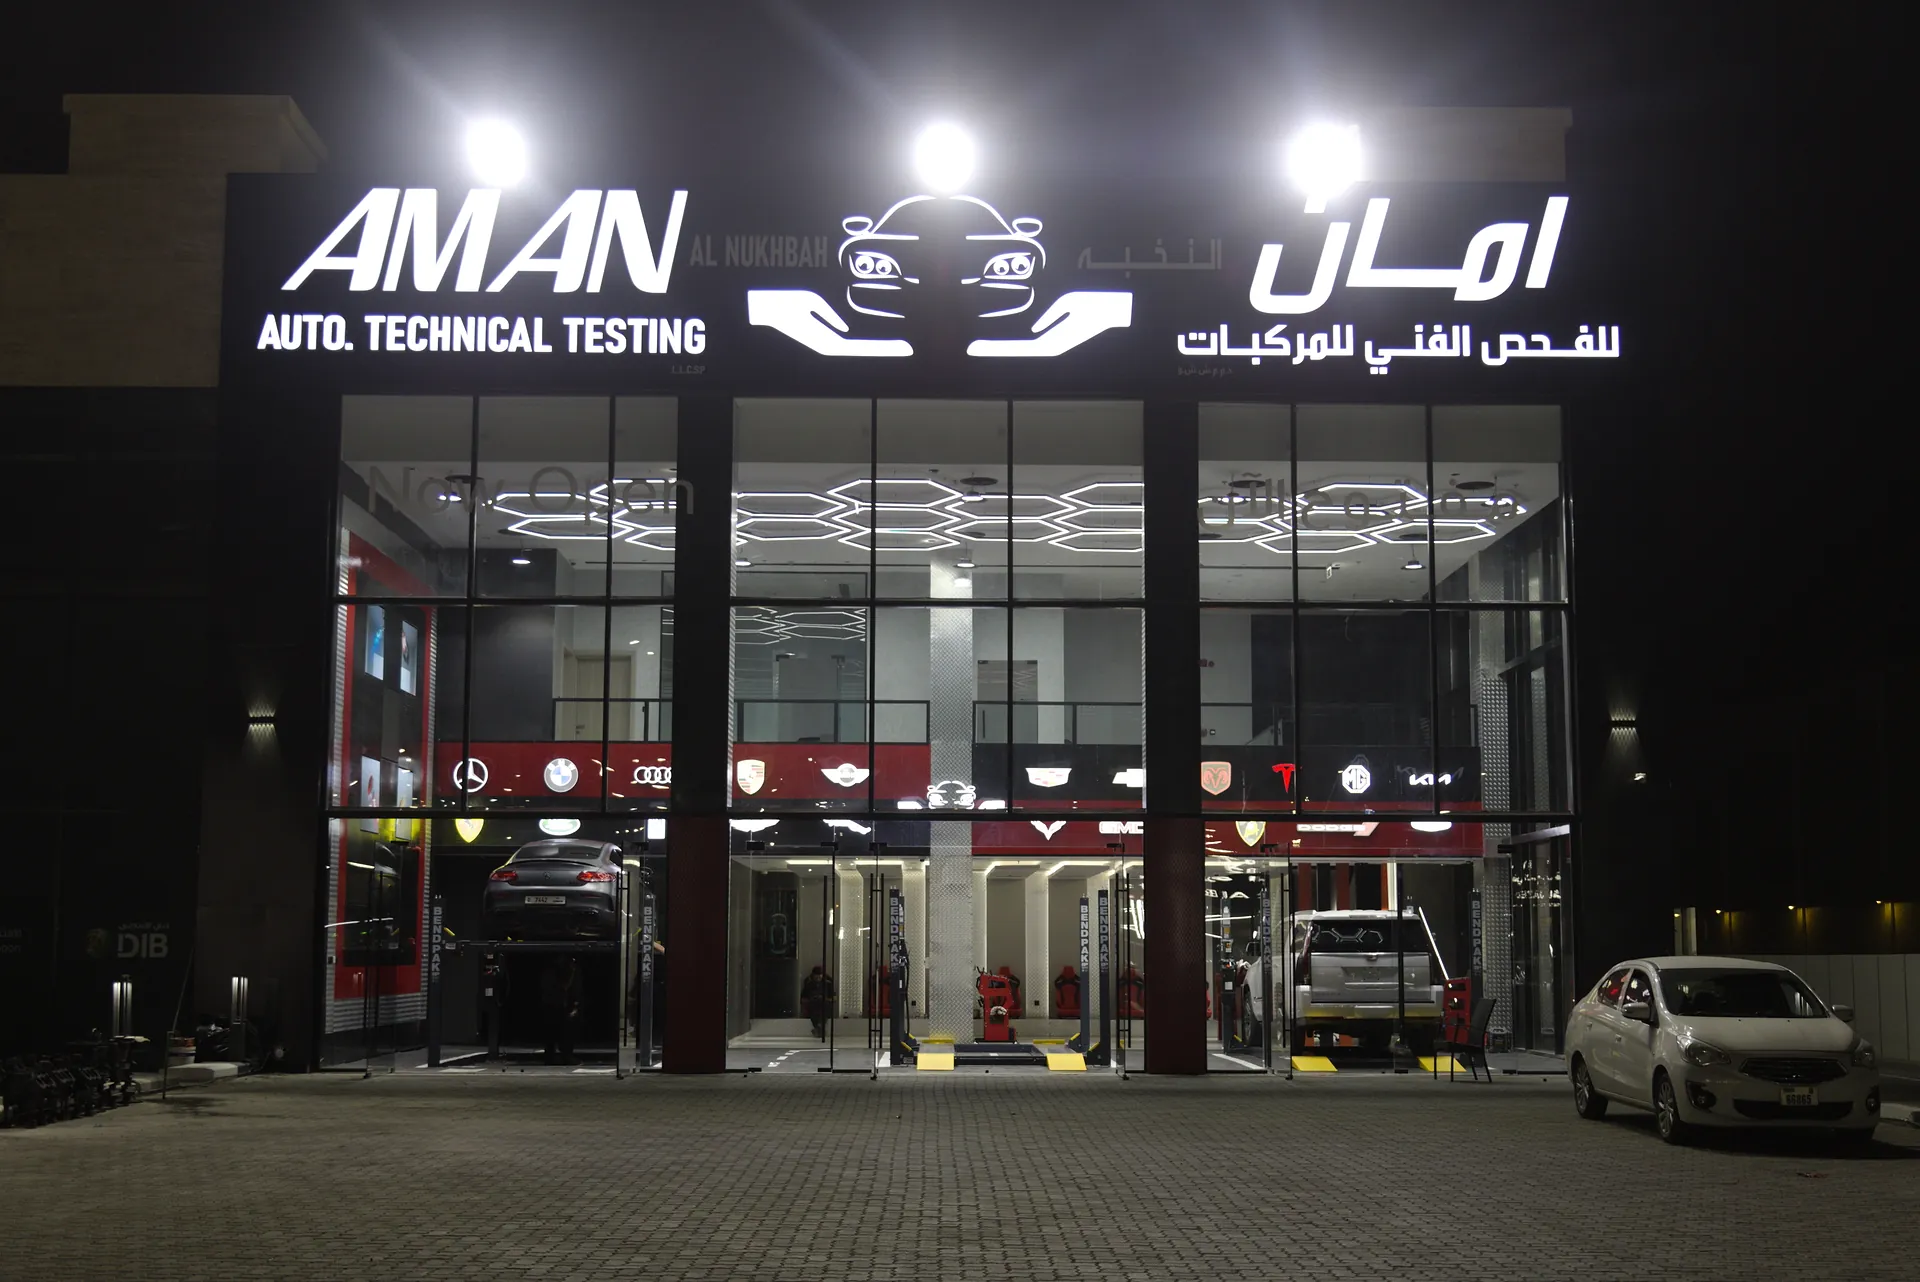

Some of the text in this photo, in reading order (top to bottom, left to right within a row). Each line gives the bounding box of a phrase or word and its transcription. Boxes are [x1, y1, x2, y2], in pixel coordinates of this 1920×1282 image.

[281, 187, 689, 294] AMAN
[690, 234, 828, 268] AL NUKHBAH
[1249, 188, 1569, 314] امان
[257, 313, 706, 355] AUTO. TECHNICAL TESTING
[1177, 323, 1620, 374] للفحص الفني للمركبات
[369, 465, 694, 526] Now Open
[117, 932, 169, 958] DIB
[431, 906, 442, 971] BENDPAK
[642, 906, 652, 971] BENDPAK
[890, 897, 899, 962] BENDPAK
[1099, 897, 1108, 961] BENDPAK
[1472, 900, 1481, 965] BENDPAK
